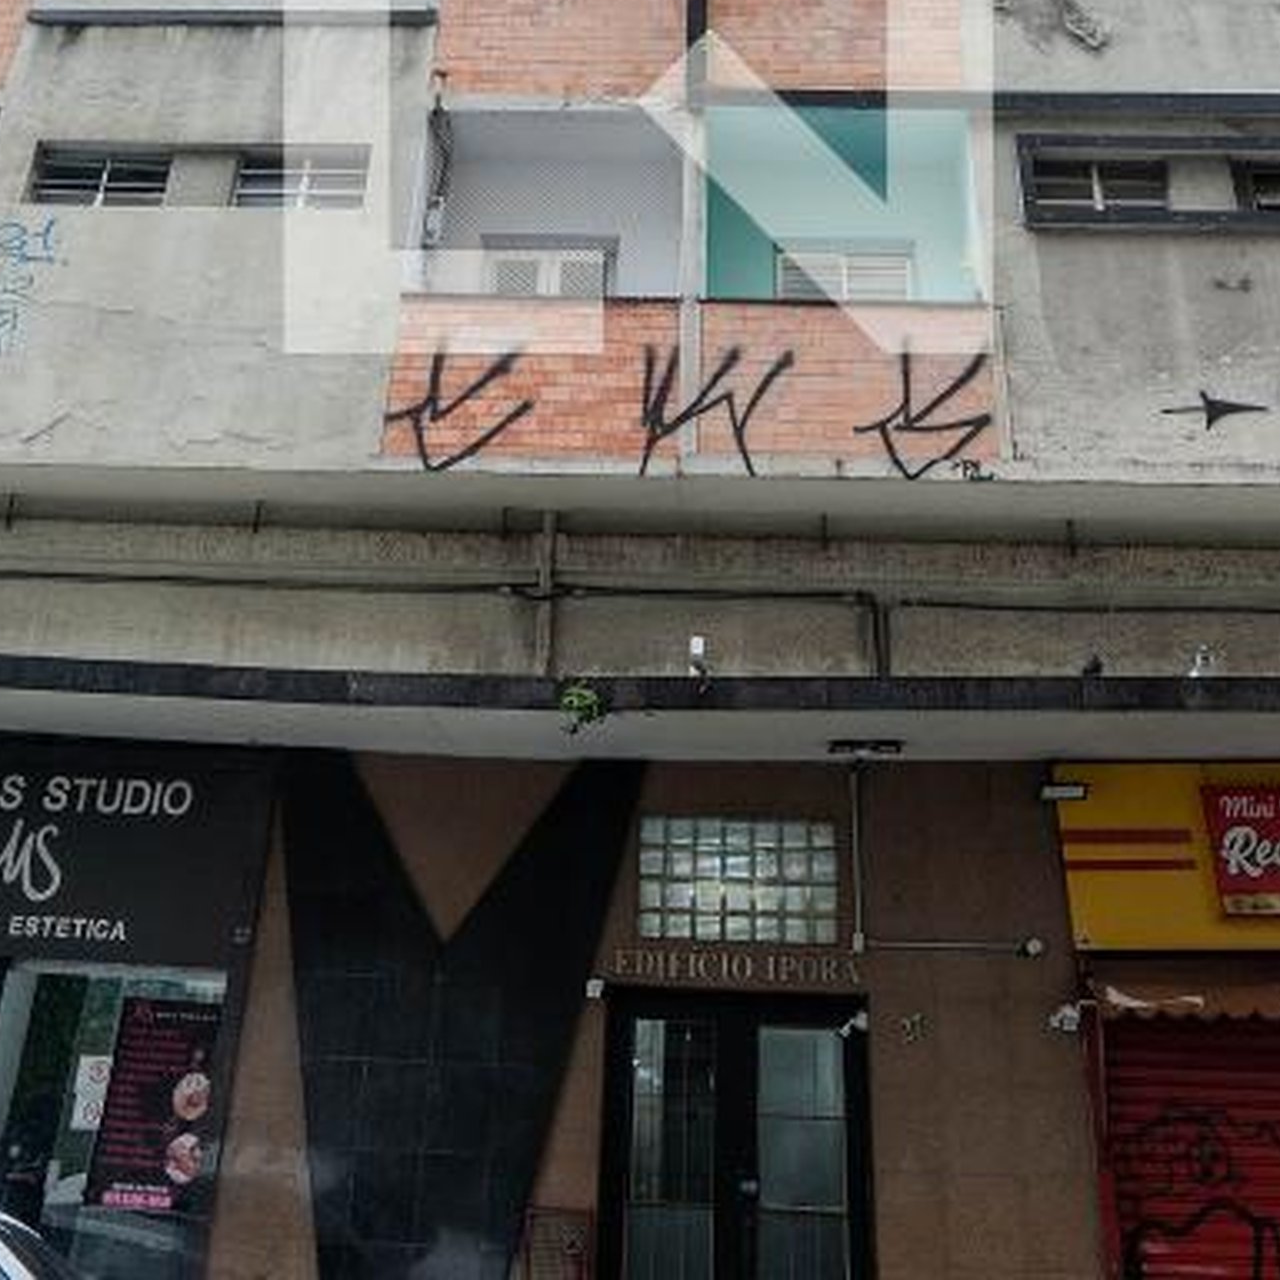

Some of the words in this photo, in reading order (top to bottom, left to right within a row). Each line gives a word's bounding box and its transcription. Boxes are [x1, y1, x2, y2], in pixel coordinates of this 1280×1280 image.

[42, 775, 194, 815] STUDIO
[1220, 795, 1276, 819] Mini
[8, 915, 127, 942] ESTETICA
